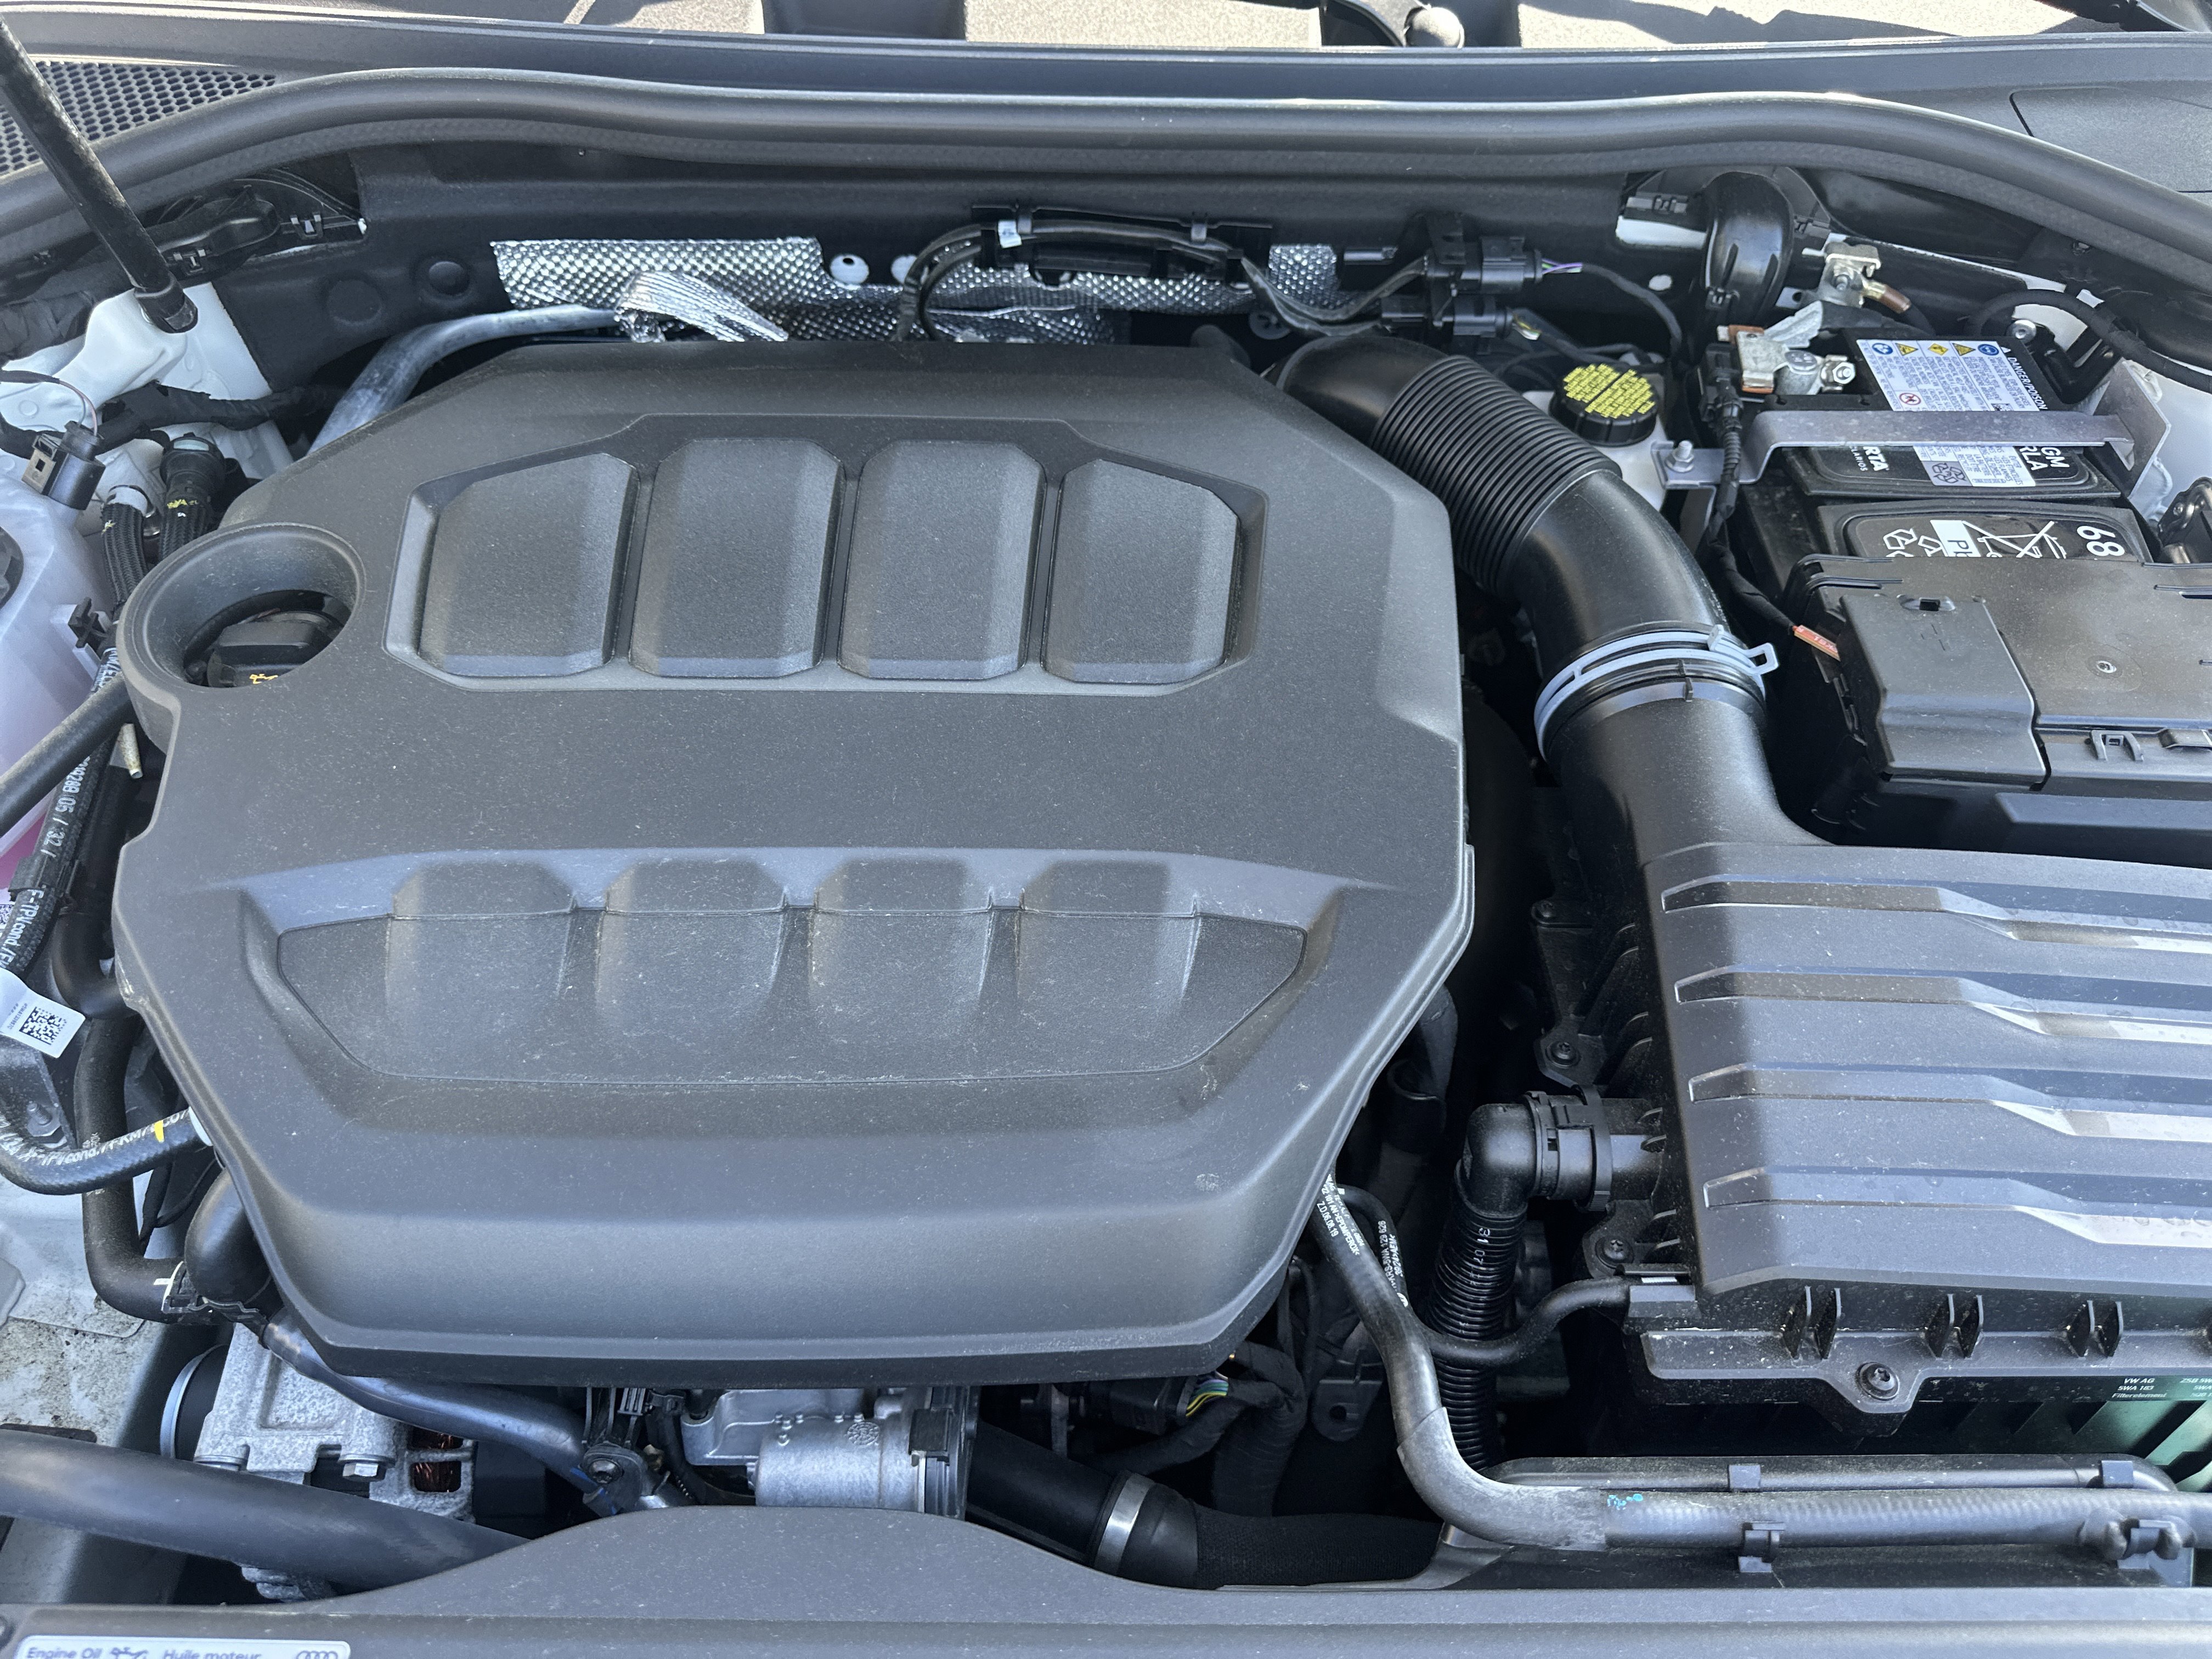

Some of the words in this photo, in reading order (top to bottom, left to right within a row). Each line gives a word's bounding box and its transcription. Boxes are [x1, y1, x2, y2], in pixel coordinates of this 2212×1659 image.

[2008, 356, 2047, 410] DANGER/POISON
[2077, 526, 2125, 556] 68
[27, 1647, 77, 1659] Engine
[82, 1647, 103, 1659] Oil
[163, 1648, 199, 1659] Huile
[204, 1650, 261, 1659] moteur
